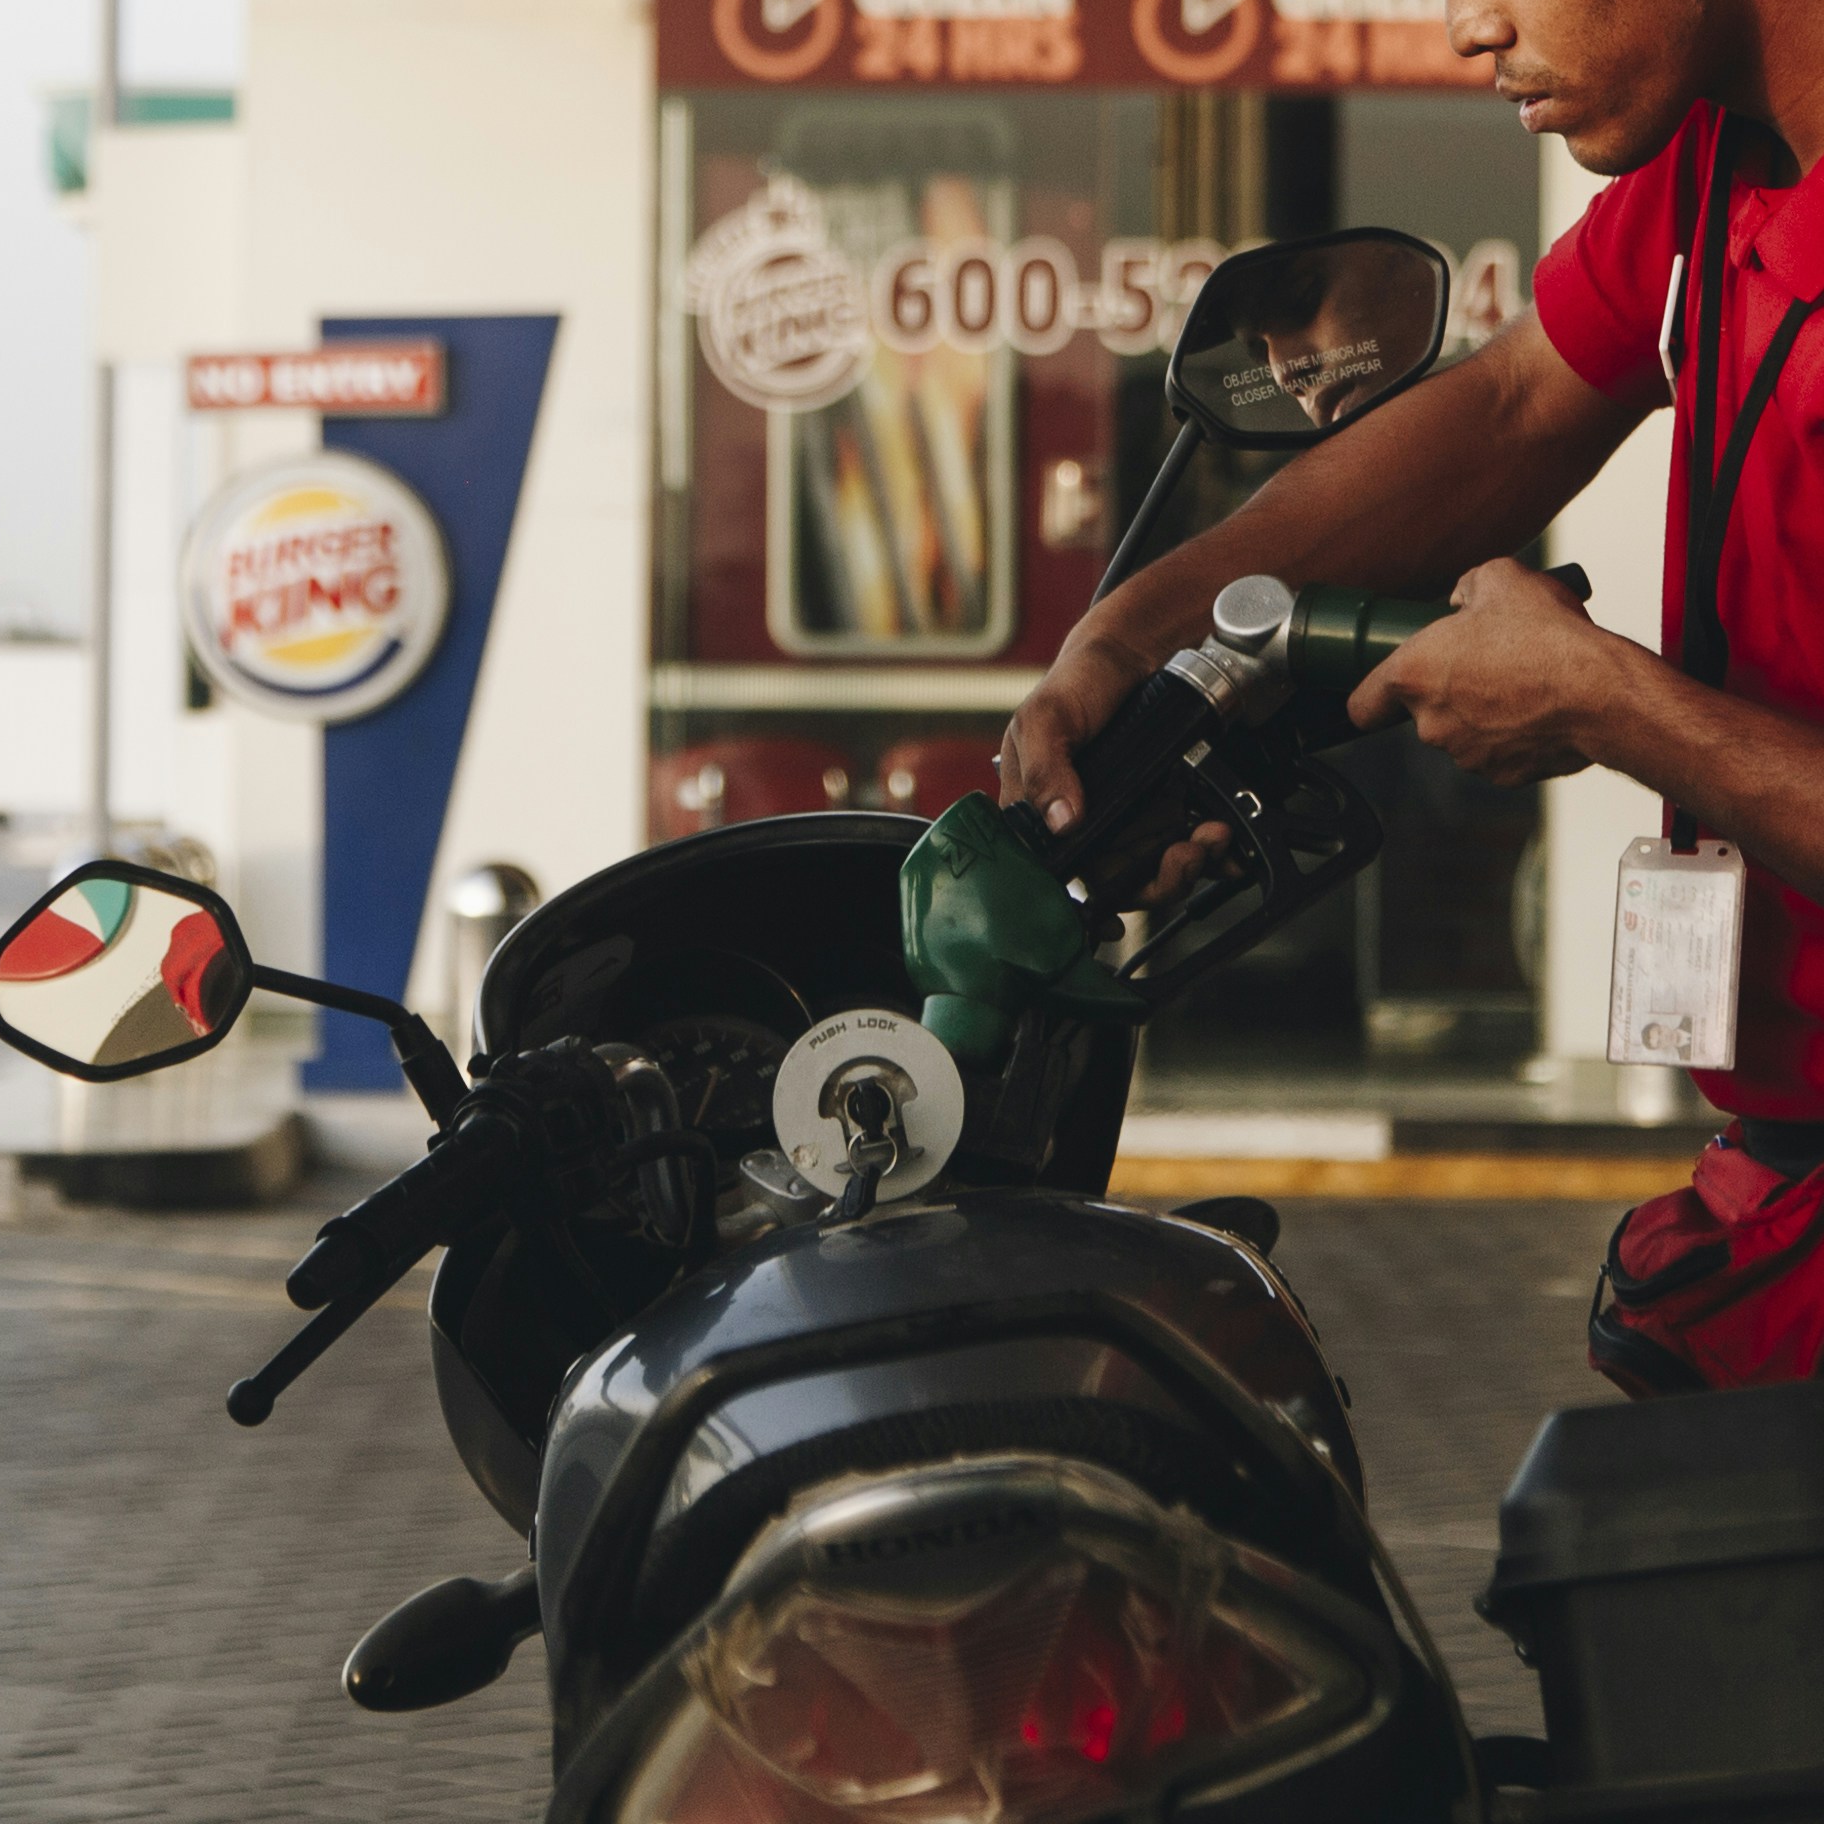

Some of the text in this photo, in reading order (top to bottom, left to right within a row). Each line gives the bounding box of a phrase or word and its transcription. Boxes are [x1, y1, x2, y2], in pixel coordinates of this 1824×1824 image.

[196, 356, 419, 403] NO ENTRY
[1223, 365, 1273, 390] OBJECTS
[1287, 355, 1310, 374] THE
[1311, 344, 1356, 369] MIRROR
[1355, 339, 1380, 357] ARE
[1231, 358, 1383, 407] CLOSER THAN THEY APPEAR
[221, 568, 399, 652] KING
[808, 1017, 899, 1050] PUSH LOCK
[822, 1508, 1047, 1566] HONDA
